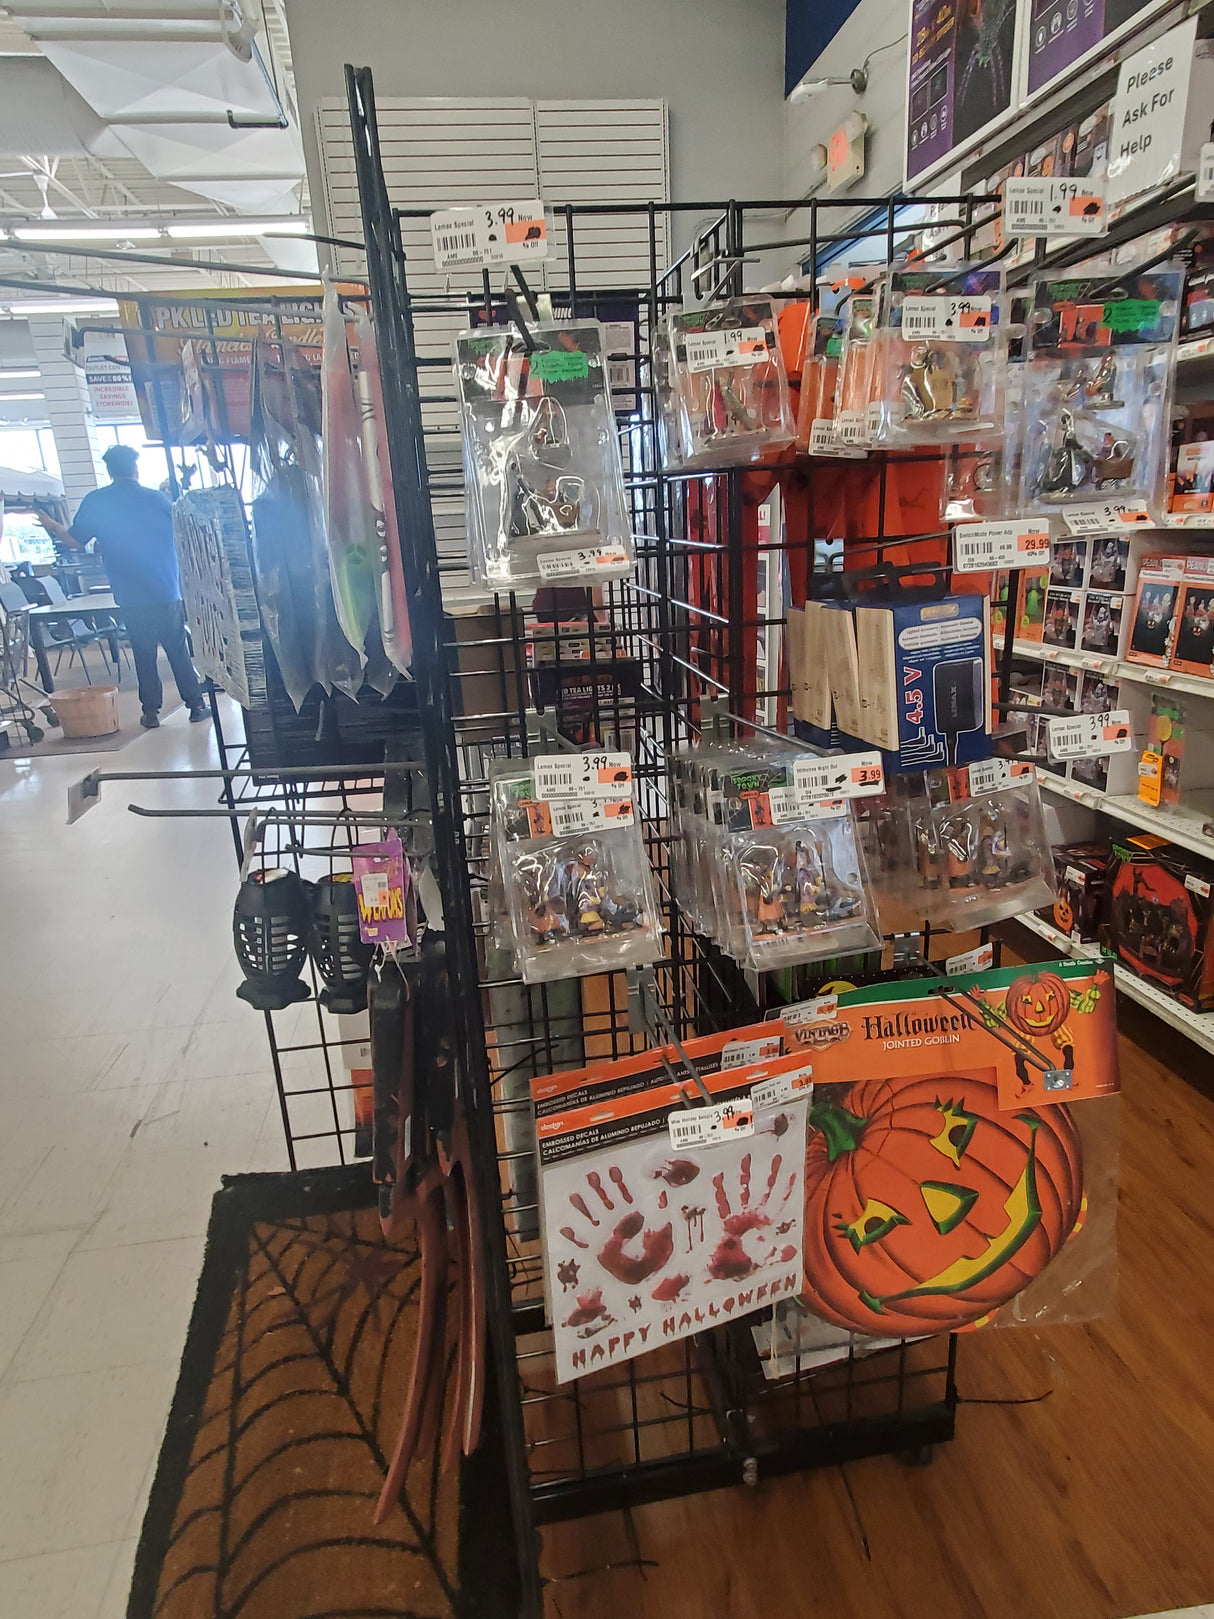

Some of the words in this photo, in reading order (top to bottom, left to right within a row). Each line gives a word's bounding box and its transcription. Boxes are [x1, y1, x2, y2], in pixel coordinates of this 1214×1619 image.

[1126, 56, 1174, 94] Please
[1122, 102, 1148, 128] Ask
[1151, 88, 1175, 112] For
[1120, 133, 1152, 159] Help
[1049, 182, 1077, 201] 1.99
[434, 222, 452, 231] Lemax
[454, 219, 474, 229] Special
[485, 207, 514, 228] 3.99
[518, 214, 533, 222] Now
[155, 306, 188, 329] PK
[951, 302, 970, 316] 3.99
[724, 330, 742, 344] 1.99
[1104, 505, 1126, 516] 3.99
[1025, 538, 1050, 550] 29.99
[577, 549, 602, 560] 3.99
[904, 666, 922, 686] V
[905, 689, 924, 724] 4.5
[1090, 713, 1110, 731] 3.99
[583, 756, 607, 772] 3.99
[737, 781, 759, 789] TOWN
[860, 769, 881, 782] 3.99
[795, 1022, 850, 1043] VINTAGE
[861, 1011, 976, 1041] Halloween
[882, 1038, 921, 1051] JOINTED
[924, 1034, 960, 1046] GOBLIN
[537, 1096, 566, 1110] EMBOSSED
[567, 1090, 588, 1100] DECALS
[589, 1089, 616, 1101] ALUMINIO
[714, 1105, 734, 1122] 3.99
[542, 1138, 590, 1156] CALCOMANÍAS
[590, 1136, 599, 1144] DE
[600, 1128, 629, 1141] ALUMINIO
[631, 1119, 661, 1132] REPUJADO
[542, 1136, 575, 1149] EMBOSSED
[576, 1129, 599, 1140] DECALS
[572, 1322, 652, 1370] HAPPY
[662, 1273, 797, 1337] HALLOWEEN
